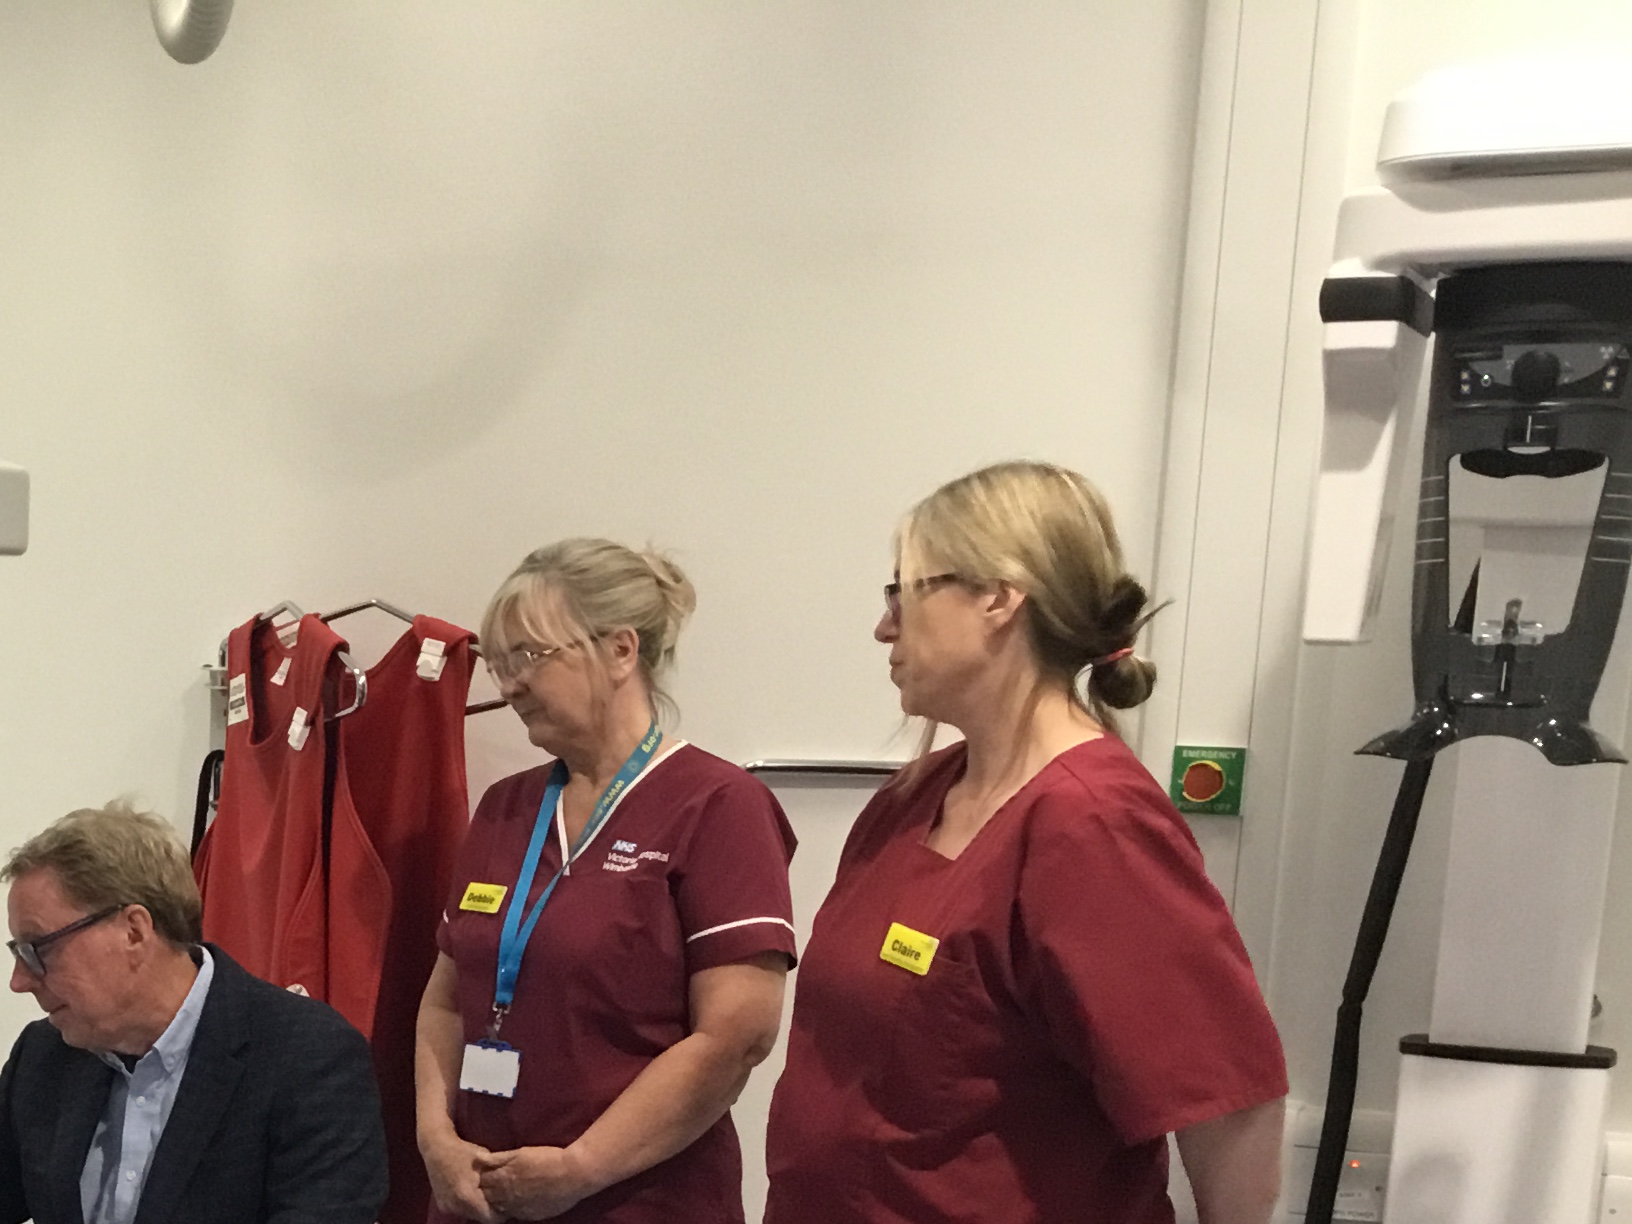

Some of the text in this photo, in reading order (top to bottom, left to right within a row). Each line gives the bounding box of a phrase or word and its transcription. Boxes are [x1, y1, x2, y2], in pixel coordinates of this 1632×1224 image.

[1182, 750, 1237, 760] EMERGENCY
[611, 839, 637, 853] NHS
[891, 938, 921, 961] Claire
